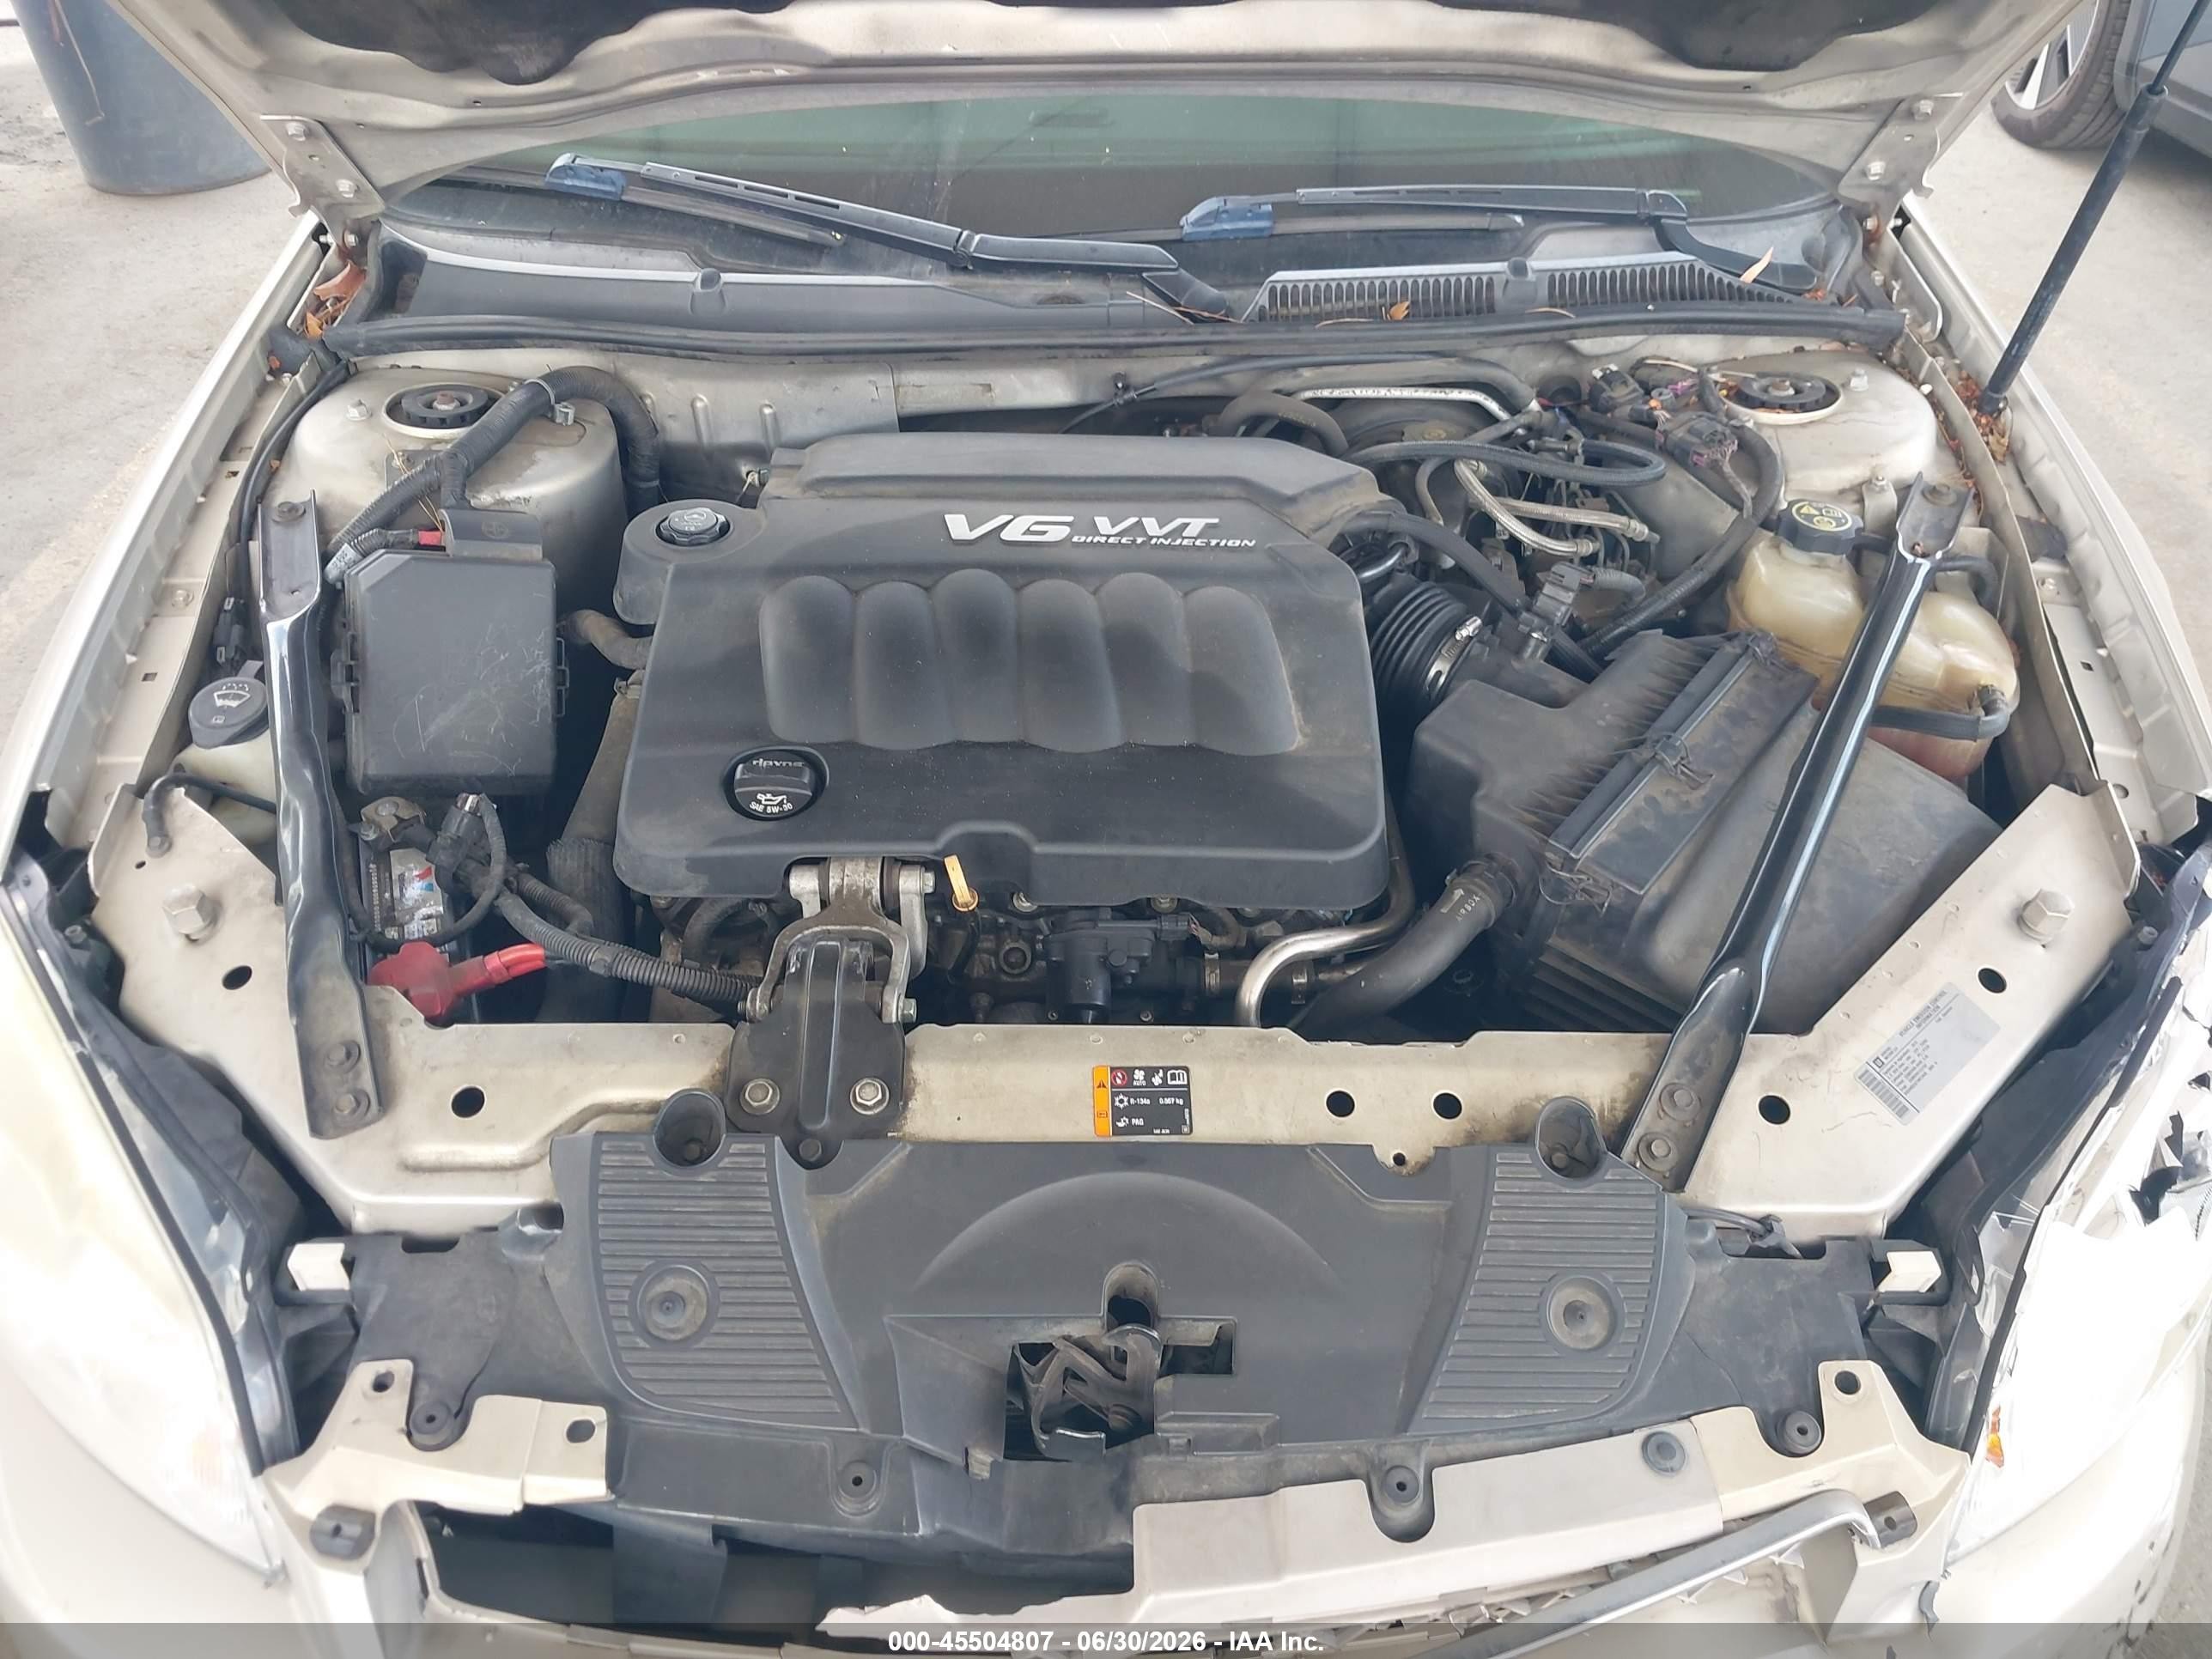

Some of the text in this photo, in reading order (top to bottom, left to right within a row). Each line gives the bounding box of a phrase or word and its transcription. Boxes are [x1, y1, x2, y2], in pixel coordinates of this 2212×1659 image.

[944, 514, 1074, 542] V6
[1093, 516, 1219, 538] VVT
[1072, 535, 1256, 547] DIRECT INJECTION
[750, 801, 793, 813] SAE 5W-30
[1131, 1118, 1145, 1127] PAG
